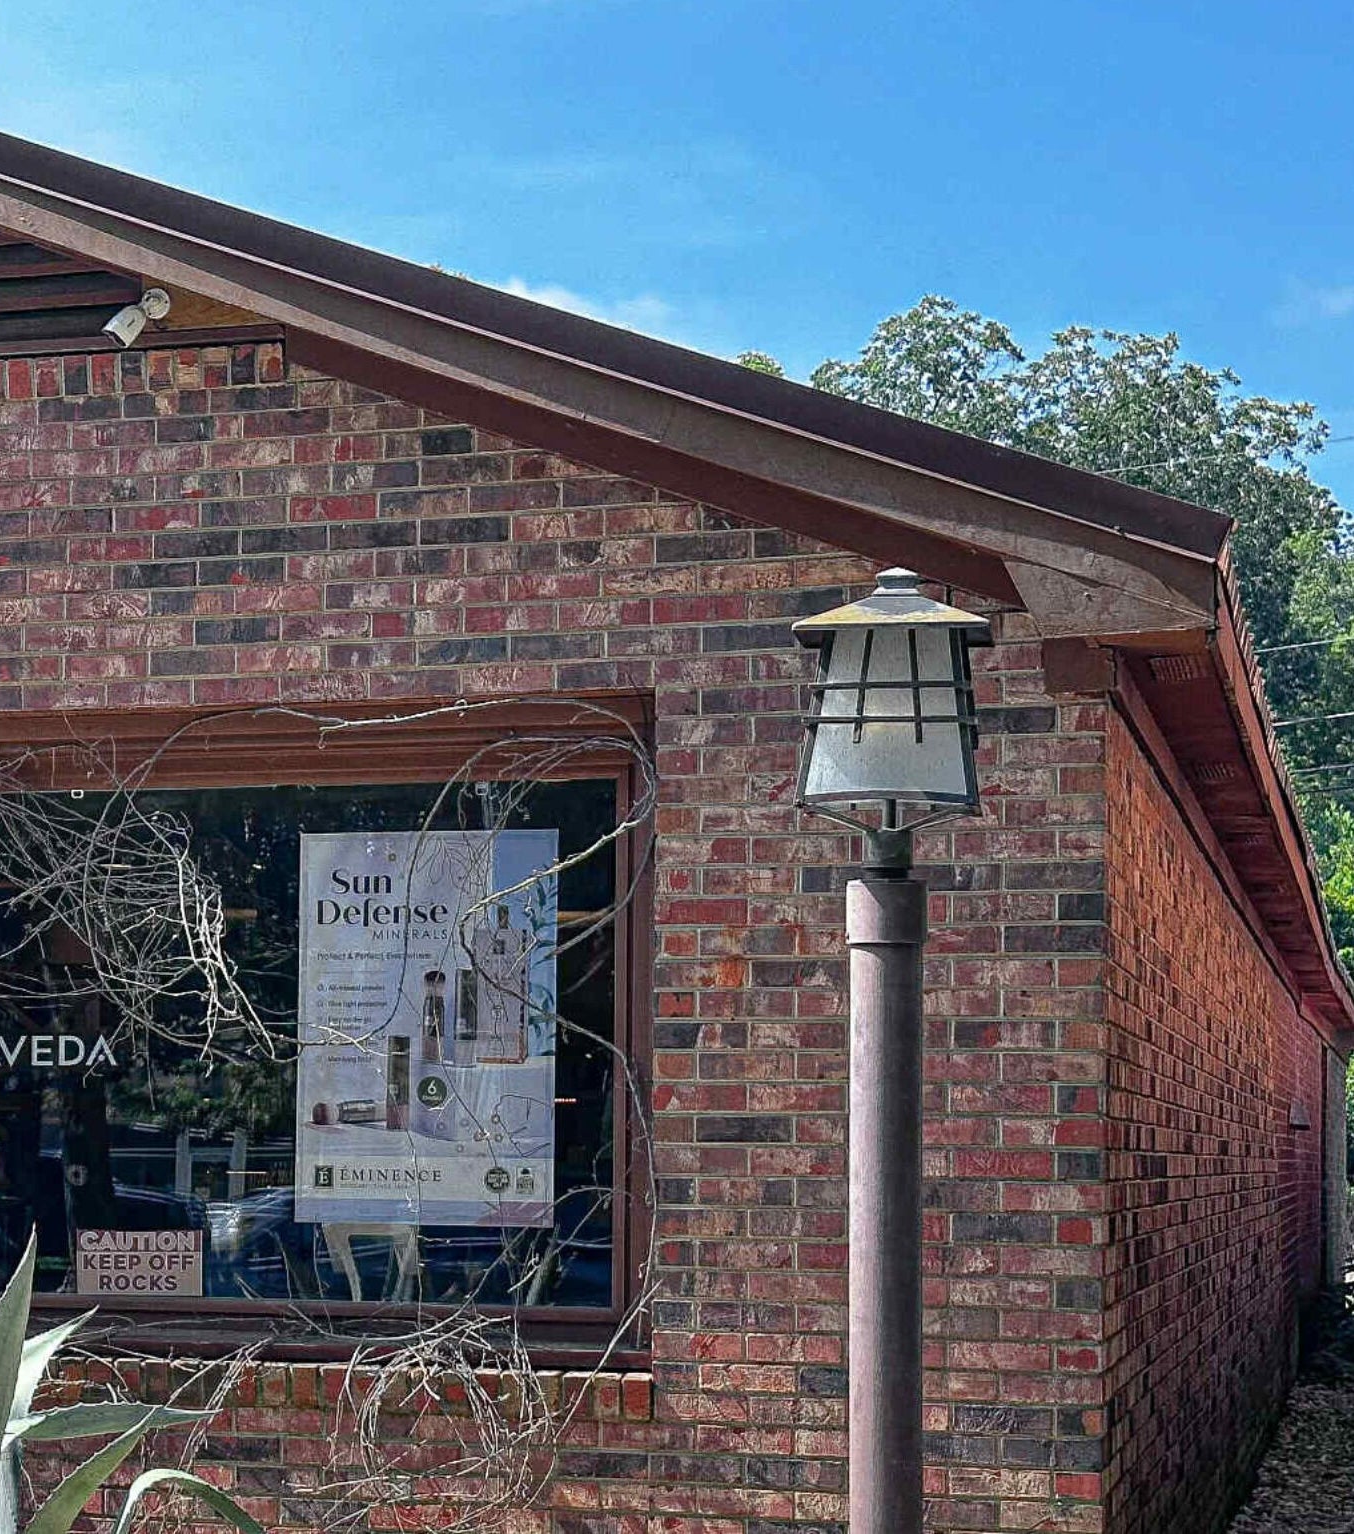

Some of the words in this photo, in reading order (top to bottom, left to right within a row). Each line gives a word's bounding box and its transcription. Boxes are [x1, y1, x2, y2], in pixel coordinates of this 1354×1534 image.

[331, 868, 392, 895] Sun
[317, 898, 449, 928] Defense
[372, 929, 448, 941] MINERALS
[427, 1079, 437, 1095] 6
[339, 1165, 442, 1183] ÉMINENCE
[80, 1231, 195, 1251] CAUTION
[83, 1253, 142, 1271] KEEP
[148, 1253, 195, 1271] OFF
[99, 1274, 178, 1291] ROCKS
